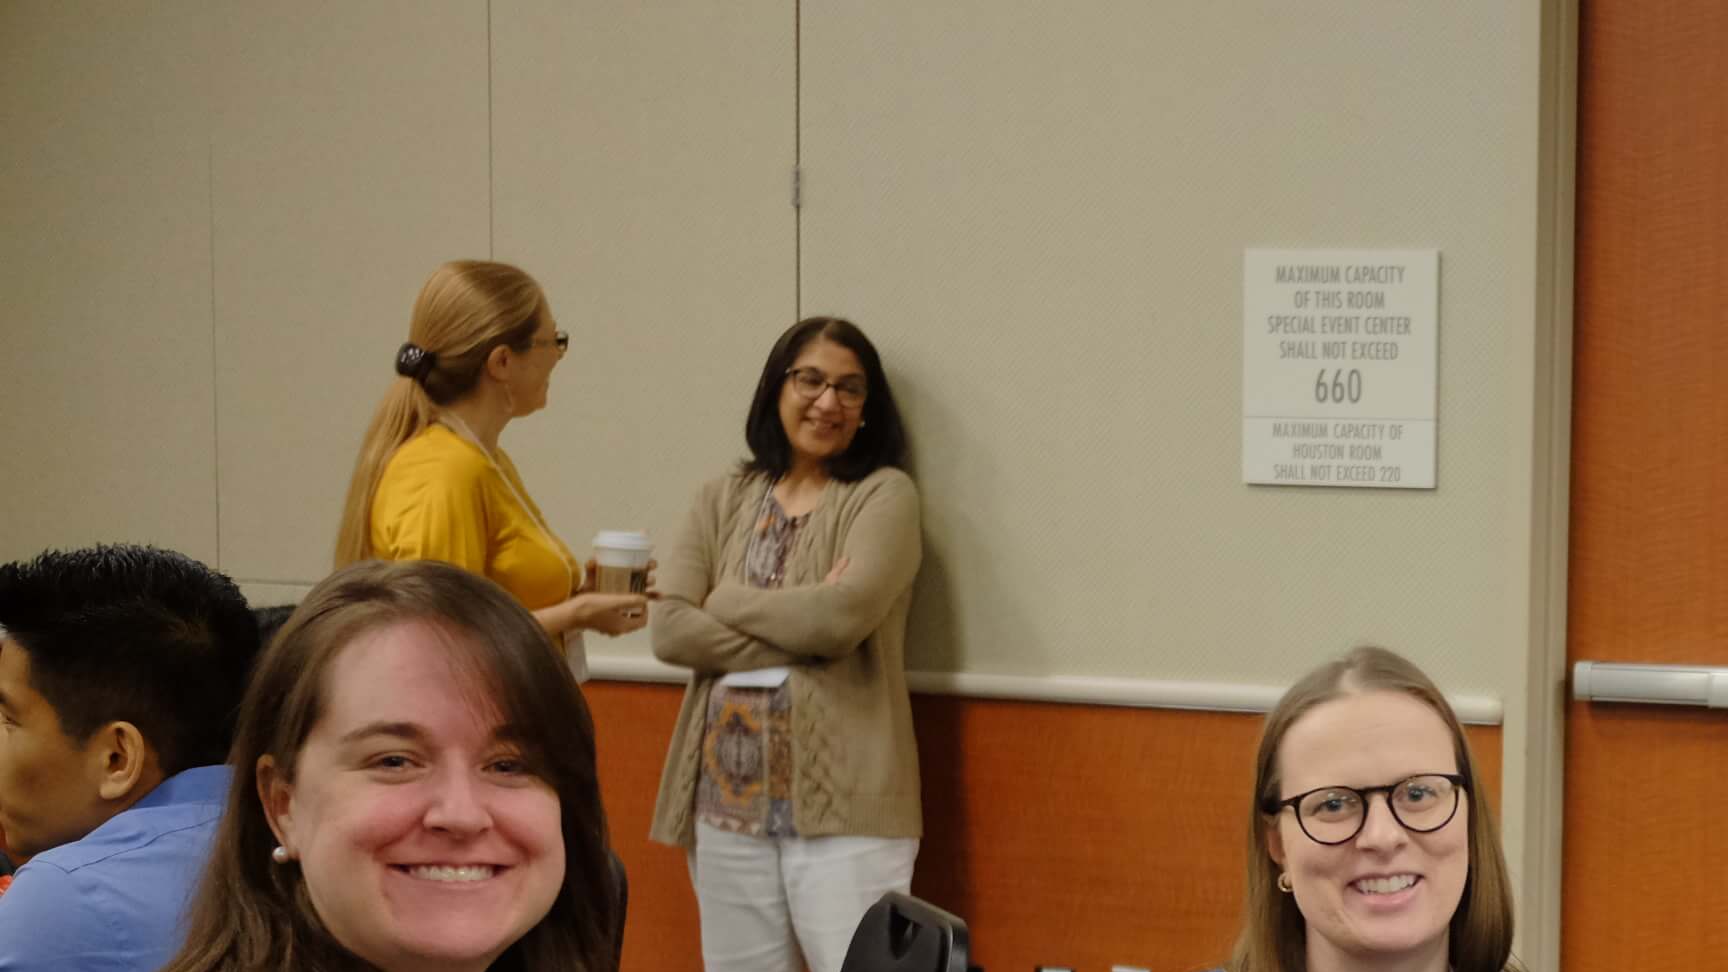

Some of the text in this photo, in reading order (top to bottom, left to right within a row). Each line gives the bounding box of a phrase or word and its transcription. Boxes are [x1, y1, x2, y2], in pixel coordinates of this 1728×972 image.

[1275, 265, 1406, 284] MAXIMUM CAPACITY
[1294, 291, 1385, 309] OF THIS ROOM
[1267, 315, 1412, 335] SPECIAL EVENT CENTER
[1280, 340, 1399, 360] SHALL NOT EXCEED
[1315, 368, 1362, 404] 660
[1272, 422, 1404, 440] MAXIMUM CAPACITY OF
[1292, 444, 1383, 461] HOUSTON ROOM
[1273, 464, 1401, 482] SHALL NOT EXCEED 220
